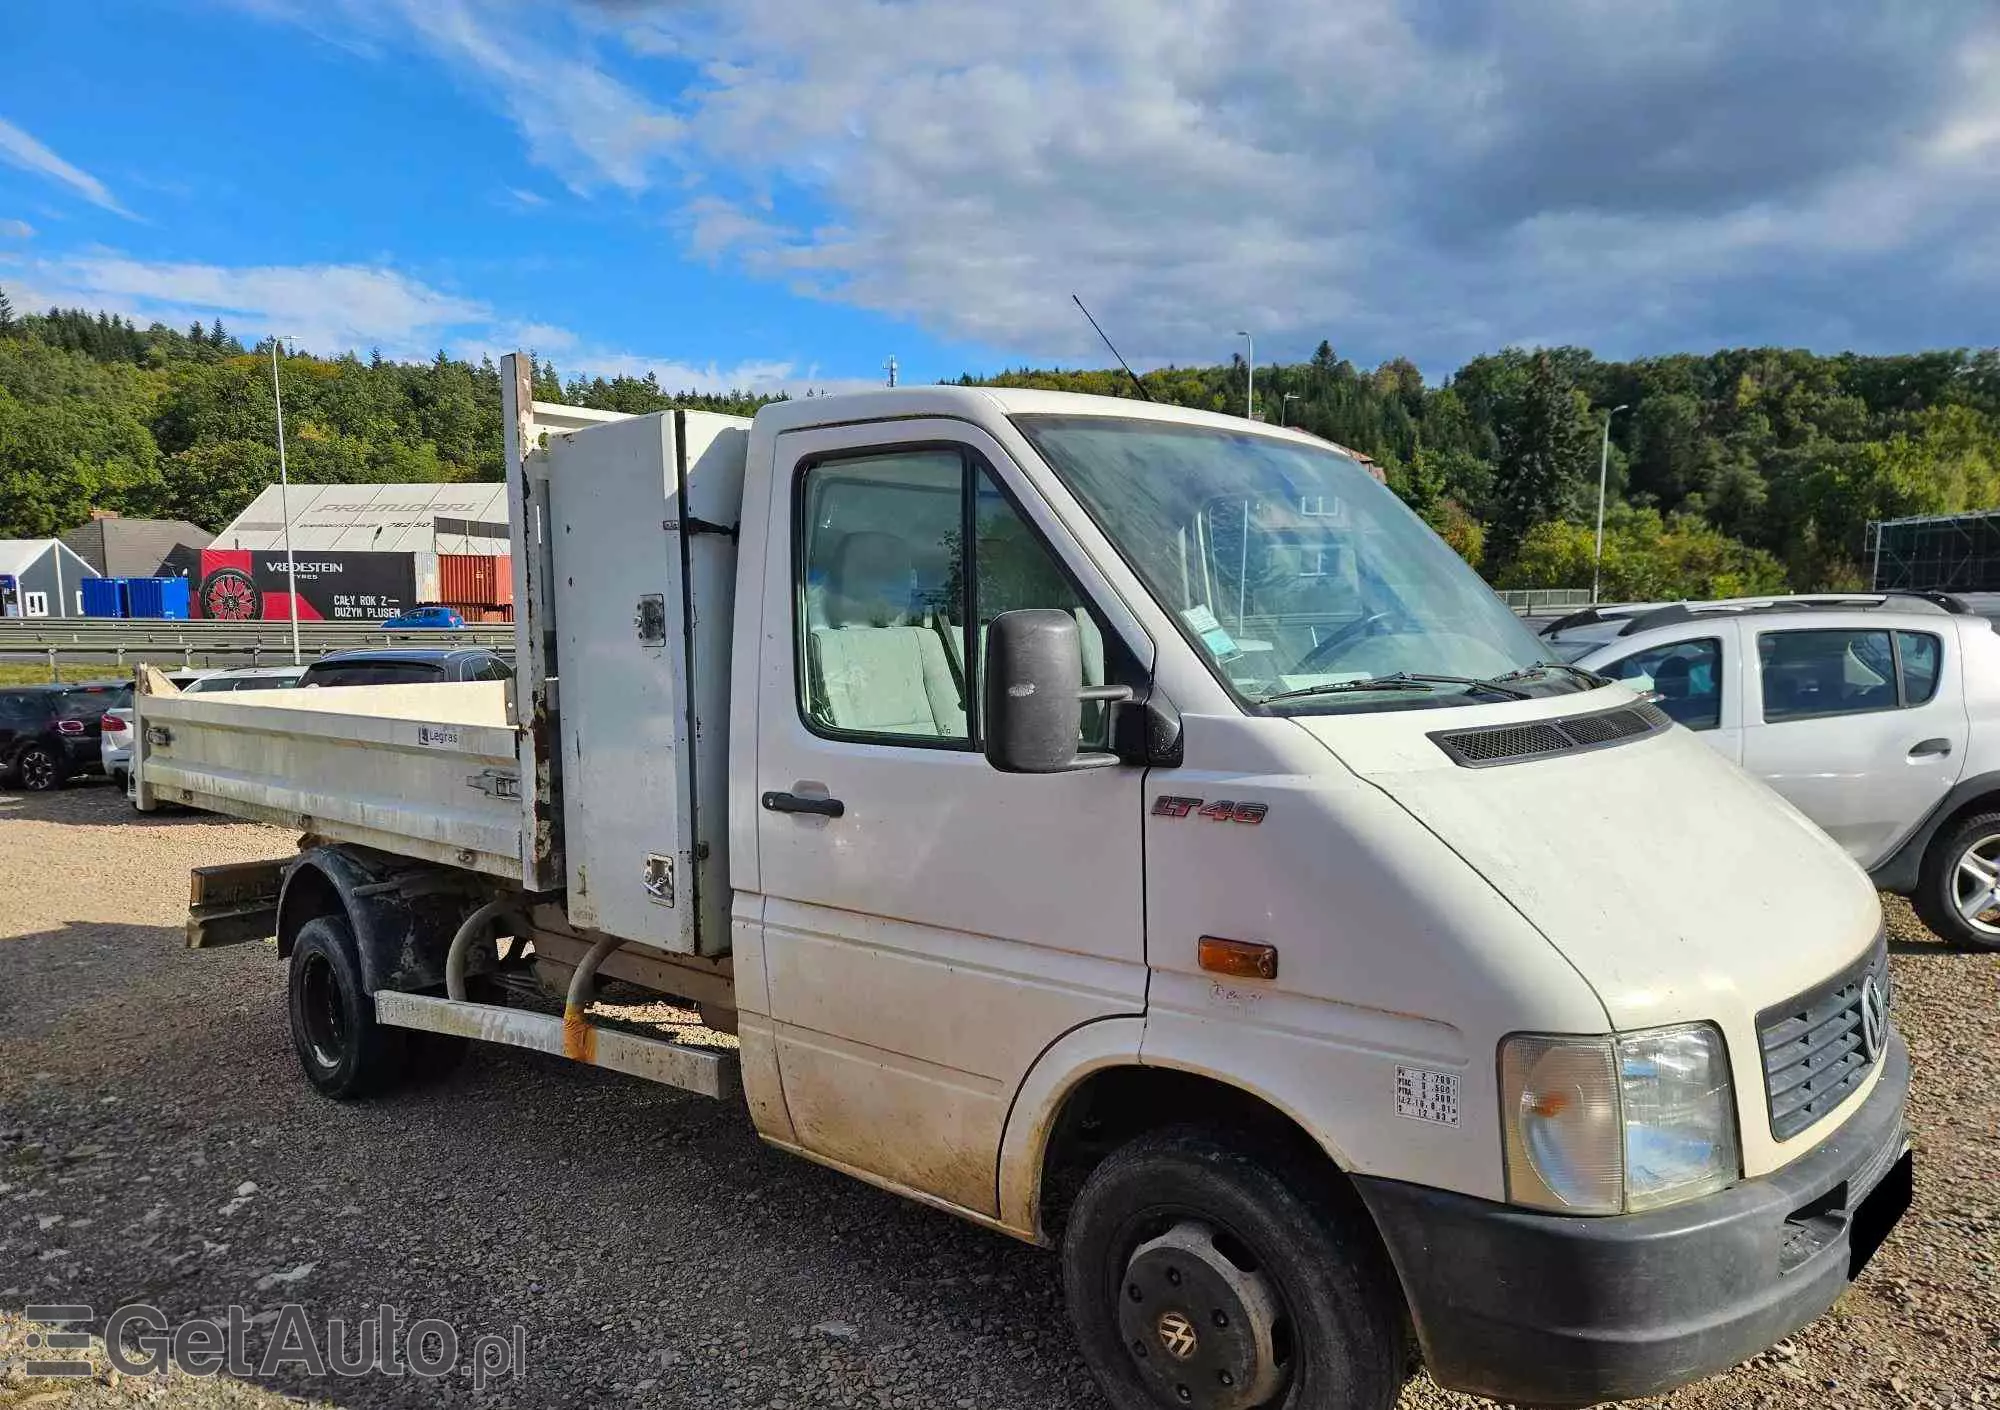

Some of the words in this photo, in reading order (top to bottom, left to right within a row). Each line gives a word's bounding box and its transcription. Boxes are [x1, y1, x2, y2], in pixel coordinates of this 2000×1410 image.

[266, 562, 343, 573] VREDESTEIN
[334, 595, 355, 606] CAŁY
[360, 595, 376, 606] ROK
[367, 608, 401, 619] PLUSEM
[429, 729, 458, 744] Legras
